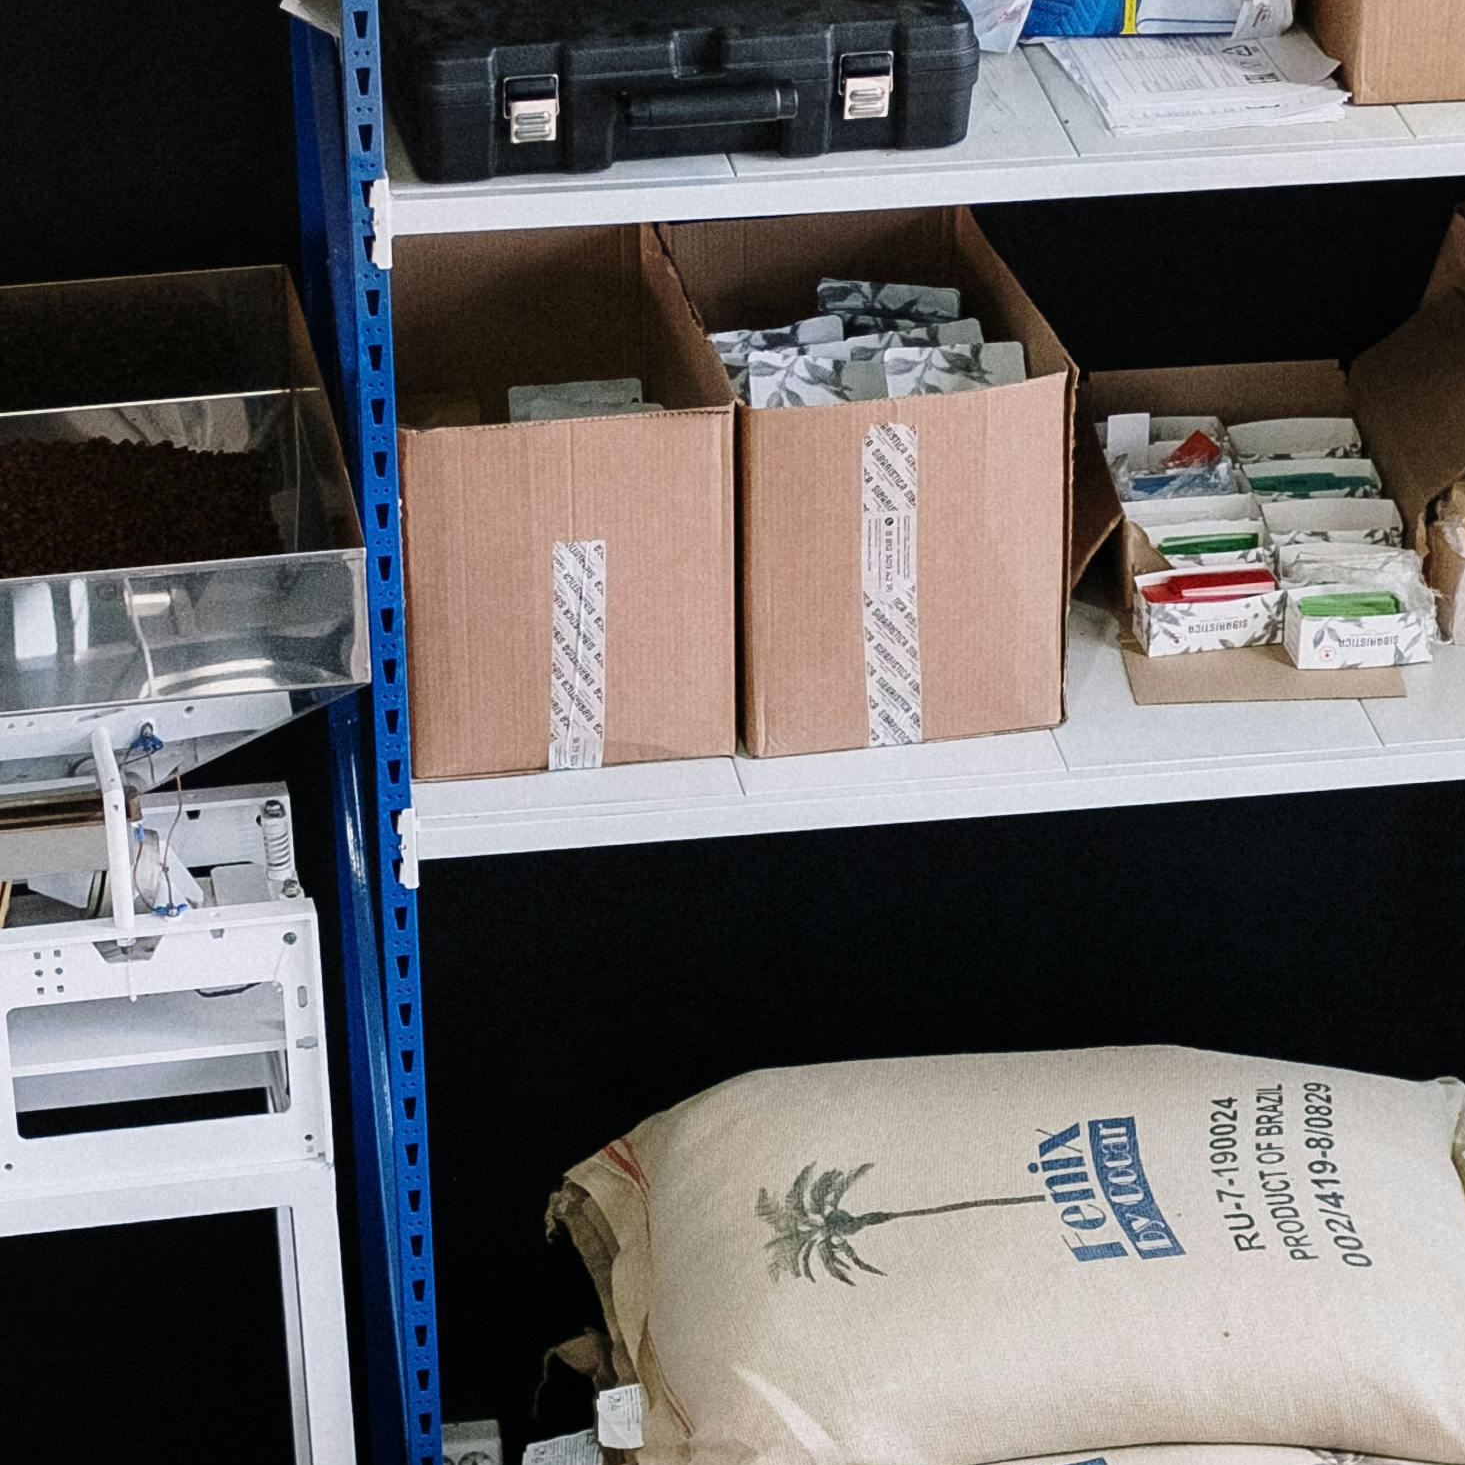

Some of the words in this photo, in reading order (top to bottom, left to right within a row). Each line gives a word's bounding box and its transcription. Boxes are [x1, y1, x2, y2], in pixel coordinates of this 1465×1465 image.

[1255, 1083, 1284, 1137] BRAZIL
[1256, 1141, 1285, 1165] OF
[1028, 1122, 1128, 1262] Fenix
[1210, 1096, 1266, 1252] RU-7-190024
[1258, 1170, 1319, 1262] PRODUCT
[1302, 1081, 1373, 1269] 002/419-8/0829
[1125, 1213, 1174, 1251] by
